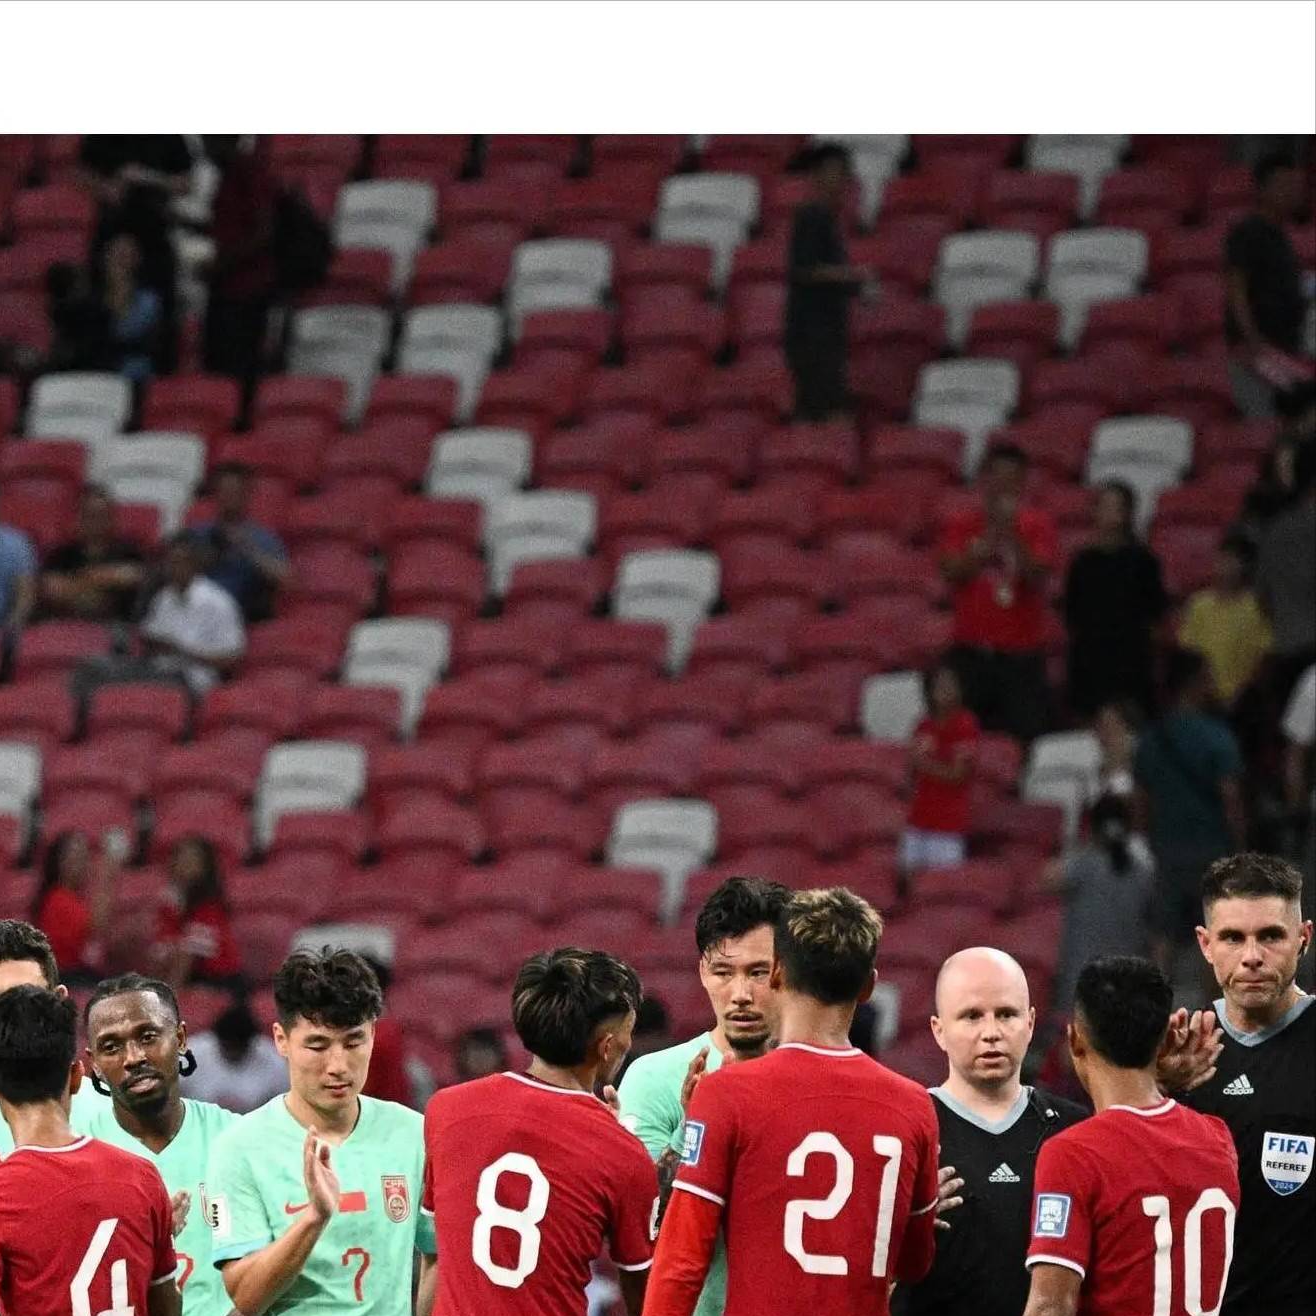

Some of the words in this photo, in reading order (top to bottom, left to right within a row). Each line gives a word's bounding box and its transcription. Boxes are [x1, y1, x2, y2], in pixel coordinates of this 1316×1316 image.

[1223, 1087, 1255, 1095] adidas
[1268, 1137, 1309, 1155] FIFA
[1266, 1160, 1308, 1172] REFEREE
[988, 1174, 1021, 1182] adidas
[783, 1131, 903, 1277] 21
[472, 1152, 550, 1289] 8
[341, 1247, 370, 1302] 7
